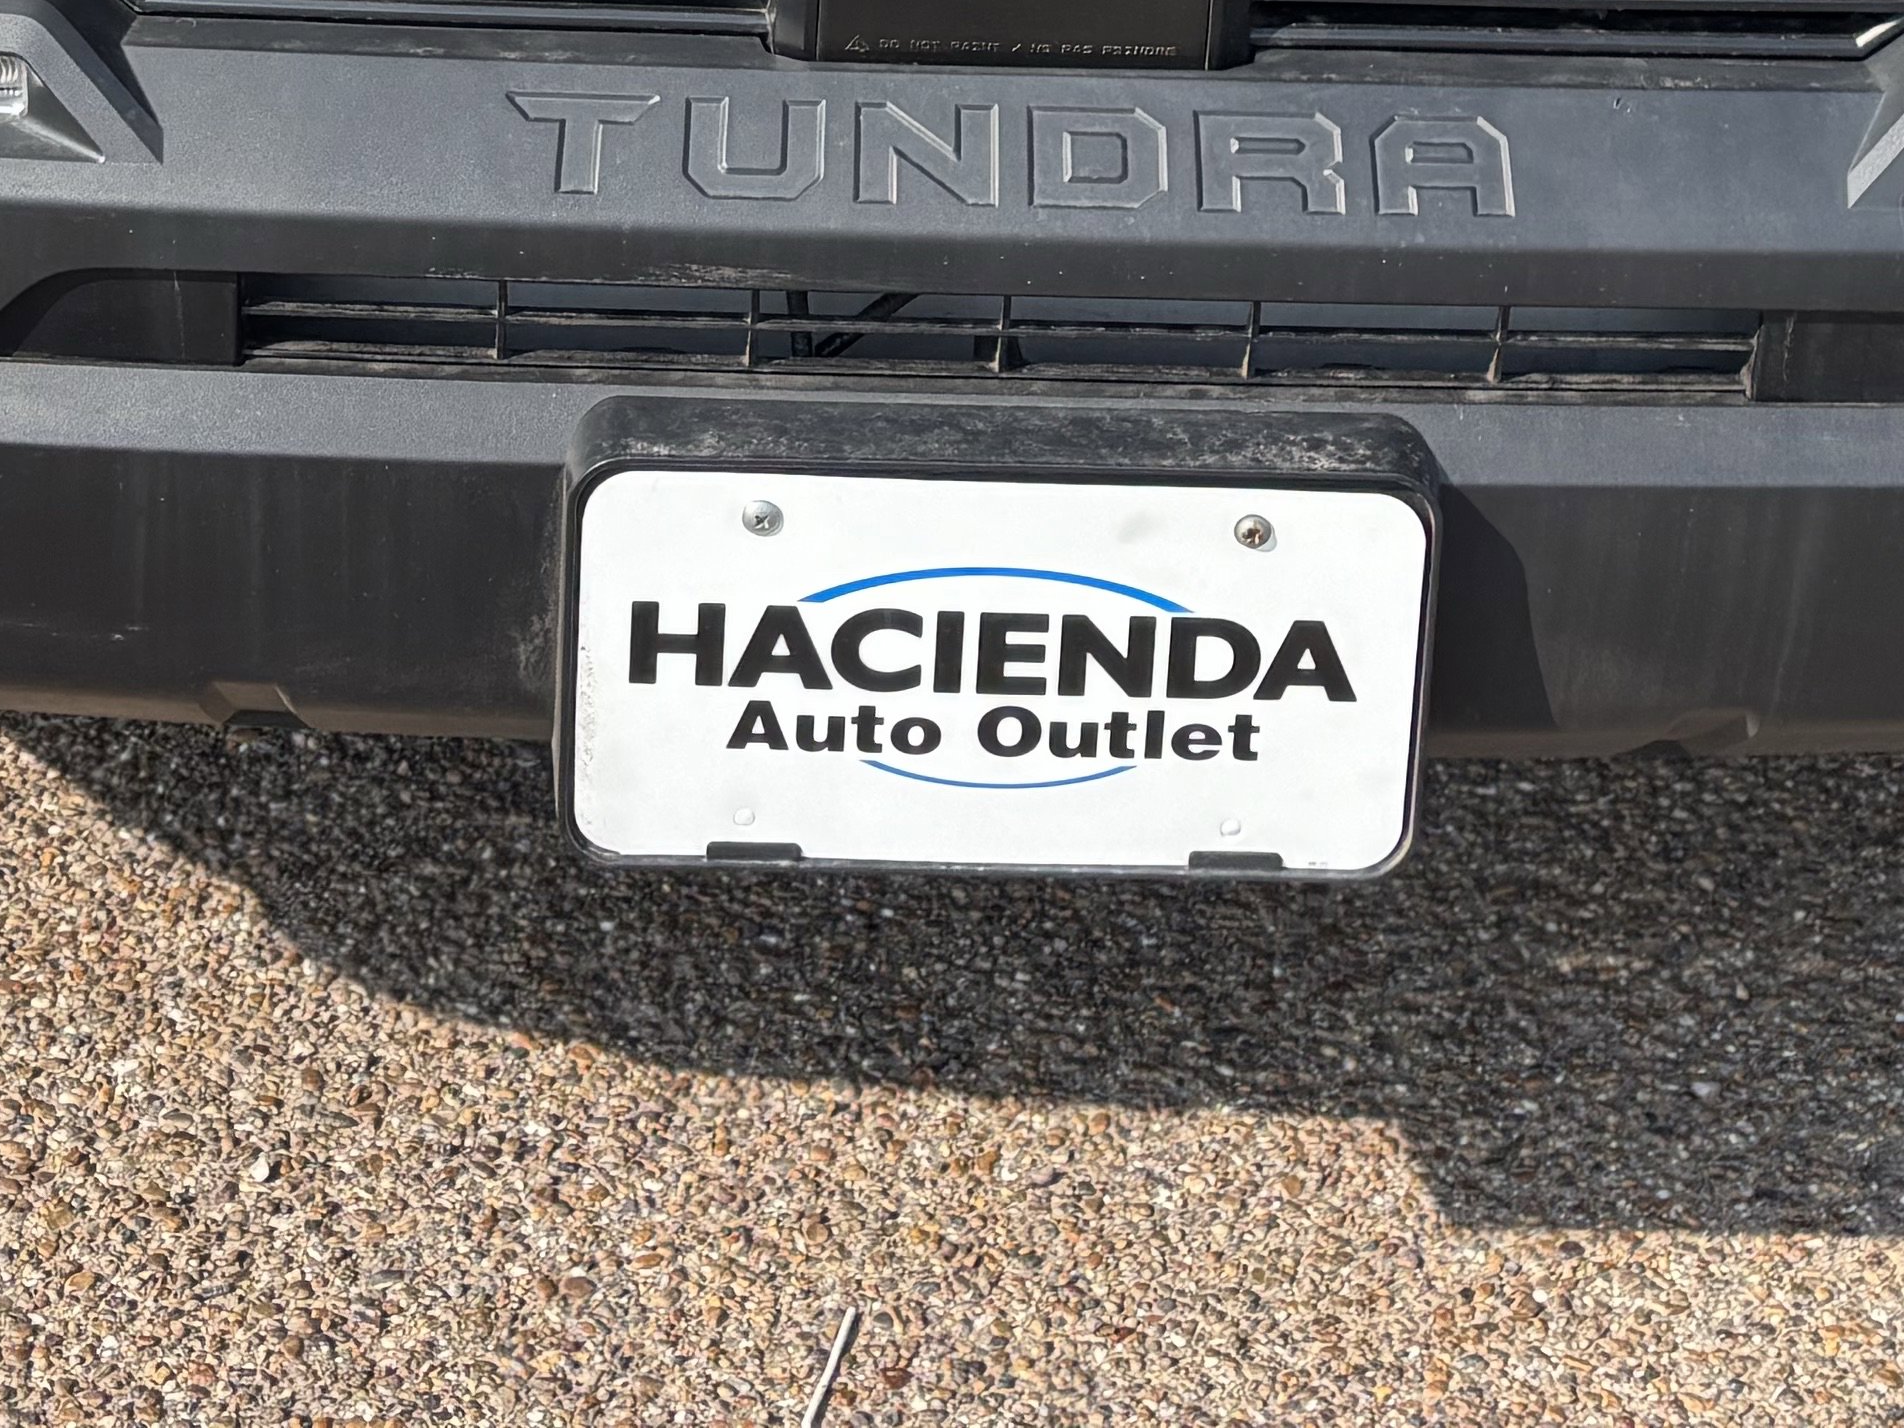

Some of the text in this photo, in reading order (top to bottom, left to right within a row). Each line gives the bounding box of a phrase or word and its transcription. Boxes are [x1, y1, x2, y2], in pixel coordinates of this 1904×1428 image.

[506, 90, 1517, 217] TUNDRA
[628, 600, 1358, 703] HACIENDA
[726, 699, 1260, 762] Auto Outlet
